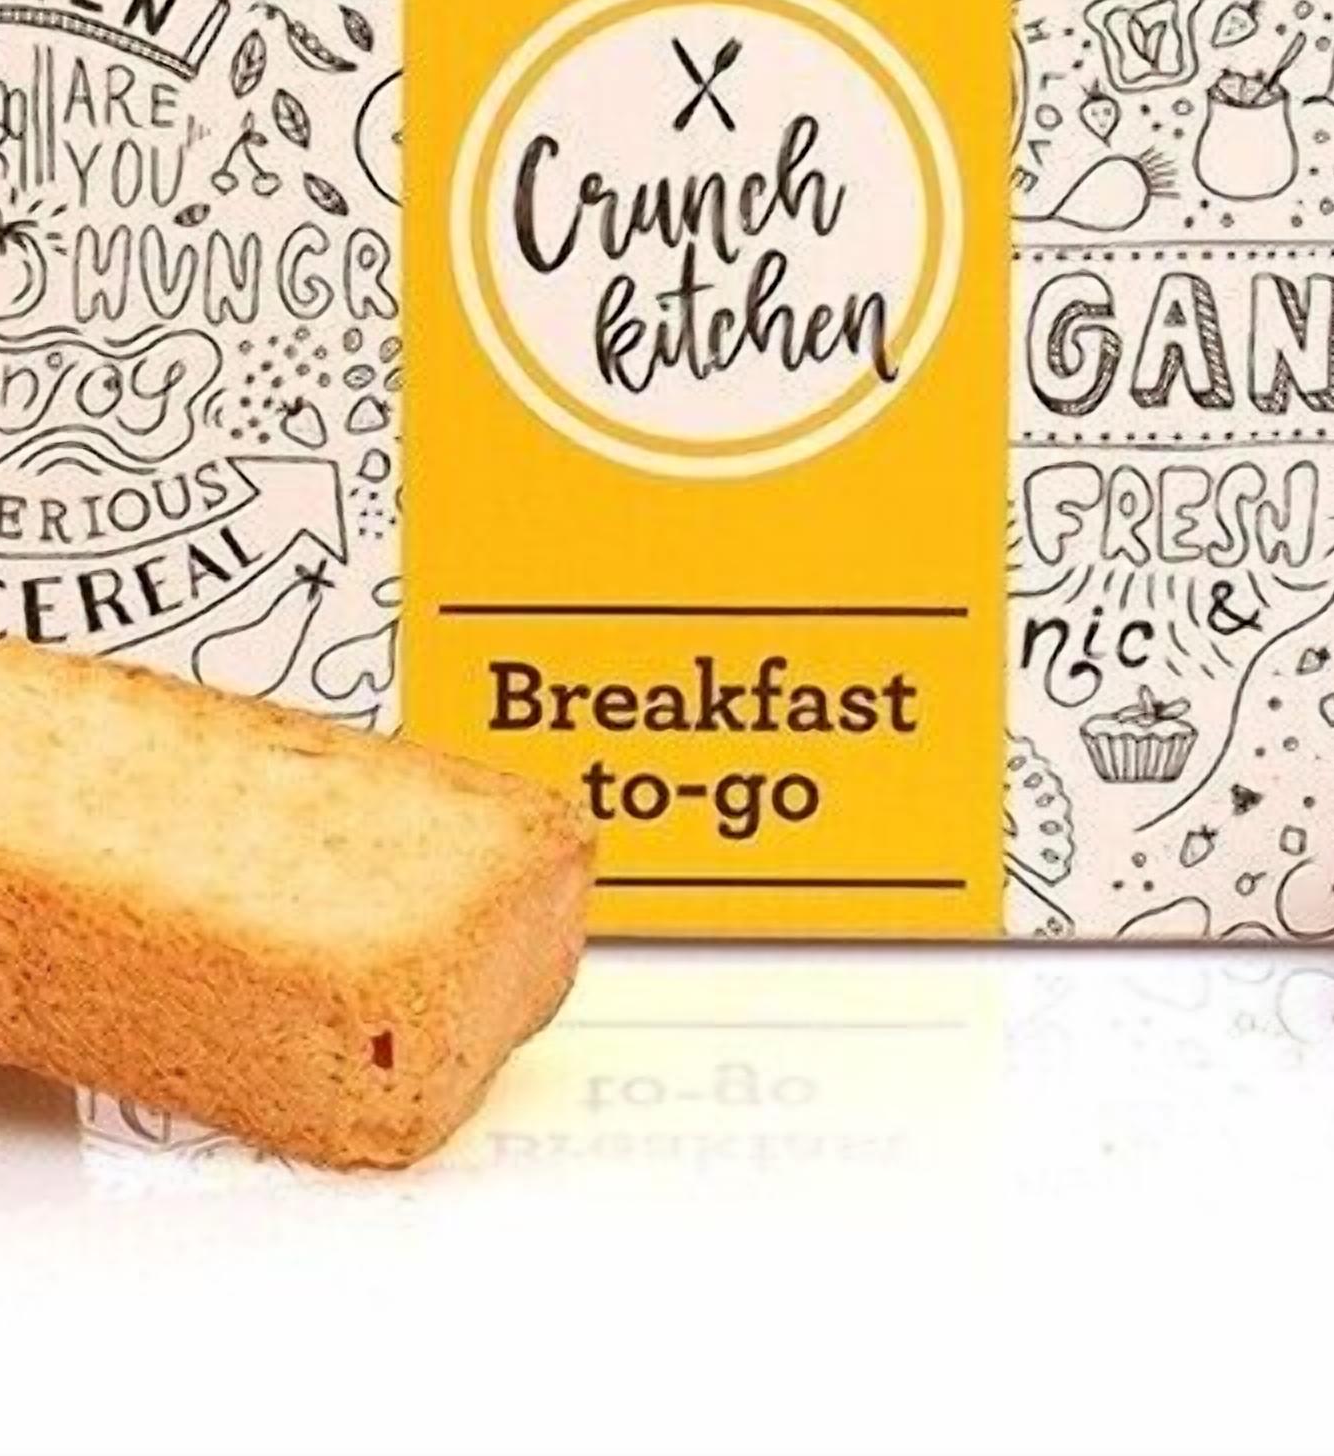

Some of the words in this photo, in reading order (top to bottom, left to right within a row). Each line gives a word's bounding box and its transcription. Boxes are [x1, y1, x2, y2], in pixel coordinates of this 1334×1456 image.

[63, 58, 180, 129] ARE
[65, 142, 185, 210] YOU
[512, 113, 847, 275] Crunch
[592, 240, 900, 394] kitchen
[1023, 461, 1320, 568] FRESH
[488, 655, 918, 734] Breakfast
[580, 760, 820, 841] to-go
